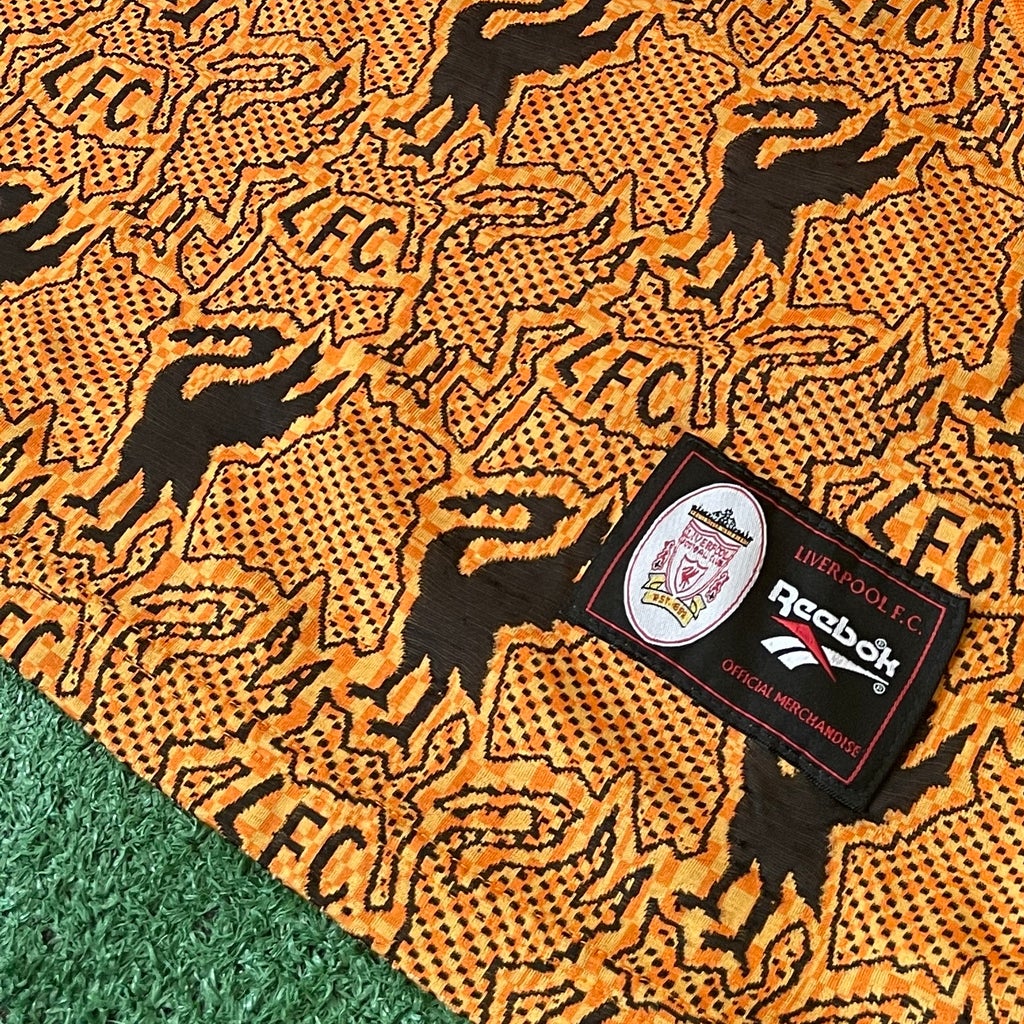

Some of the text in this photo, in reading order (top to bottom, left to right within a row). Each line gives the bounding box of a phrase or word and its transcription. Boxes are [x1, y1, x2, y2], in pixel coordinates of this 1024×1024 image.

[767, 578, 901, 678] Reebok
[793, 545, 887, 614] LIVERPOOL
[720, 658, 863, 759] OFFICIAL MERCHANDISE
